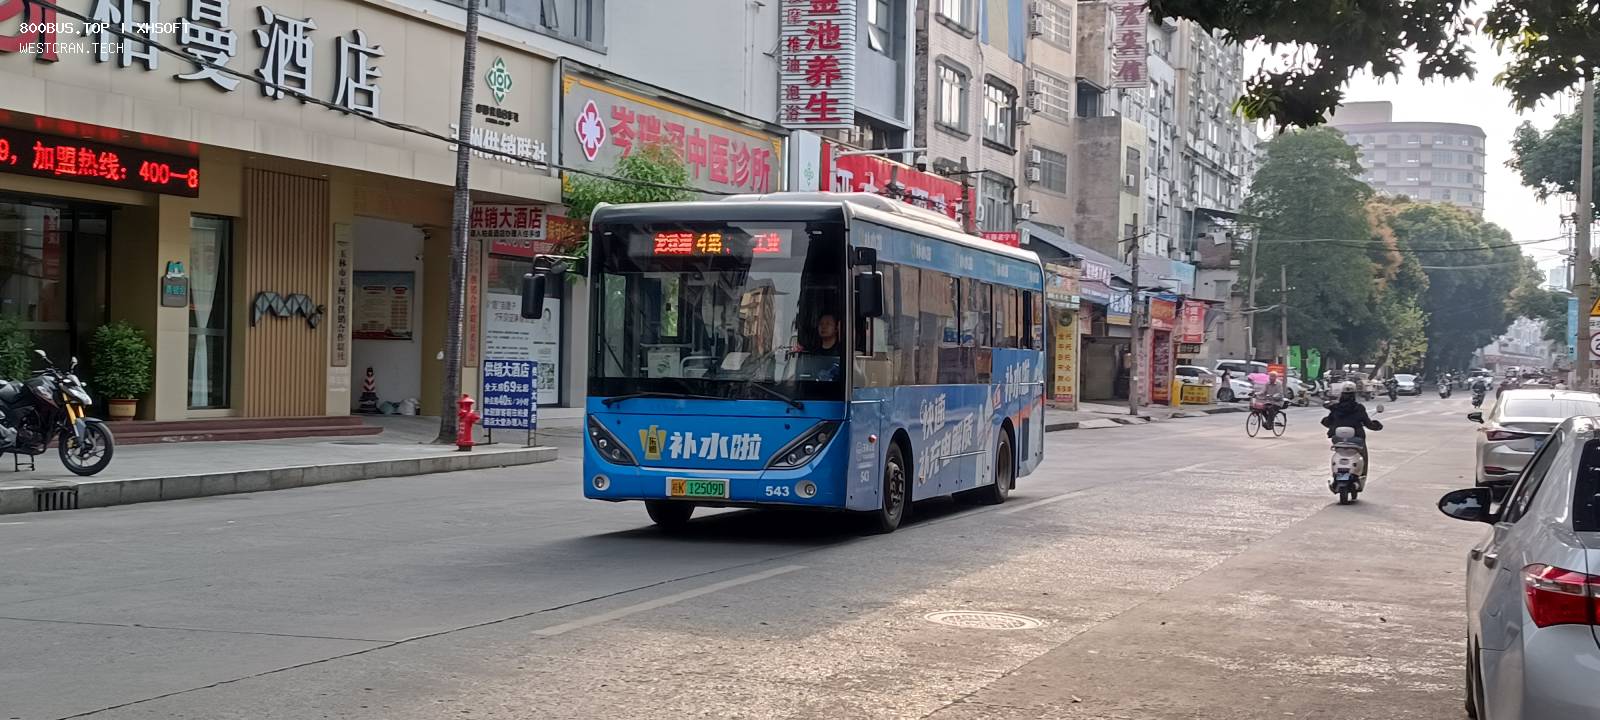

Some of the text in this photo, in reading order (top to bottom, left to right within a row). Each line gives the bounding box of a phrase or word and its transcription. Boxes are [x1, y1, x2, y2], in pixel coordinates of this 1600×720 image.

[470, 207, 543, 229] 供销大酒店
[484, 362, 529, 378] 供销大酒店
[670, 431, 762, 460] 补水啦
[765, 485, 789, 497] 543
